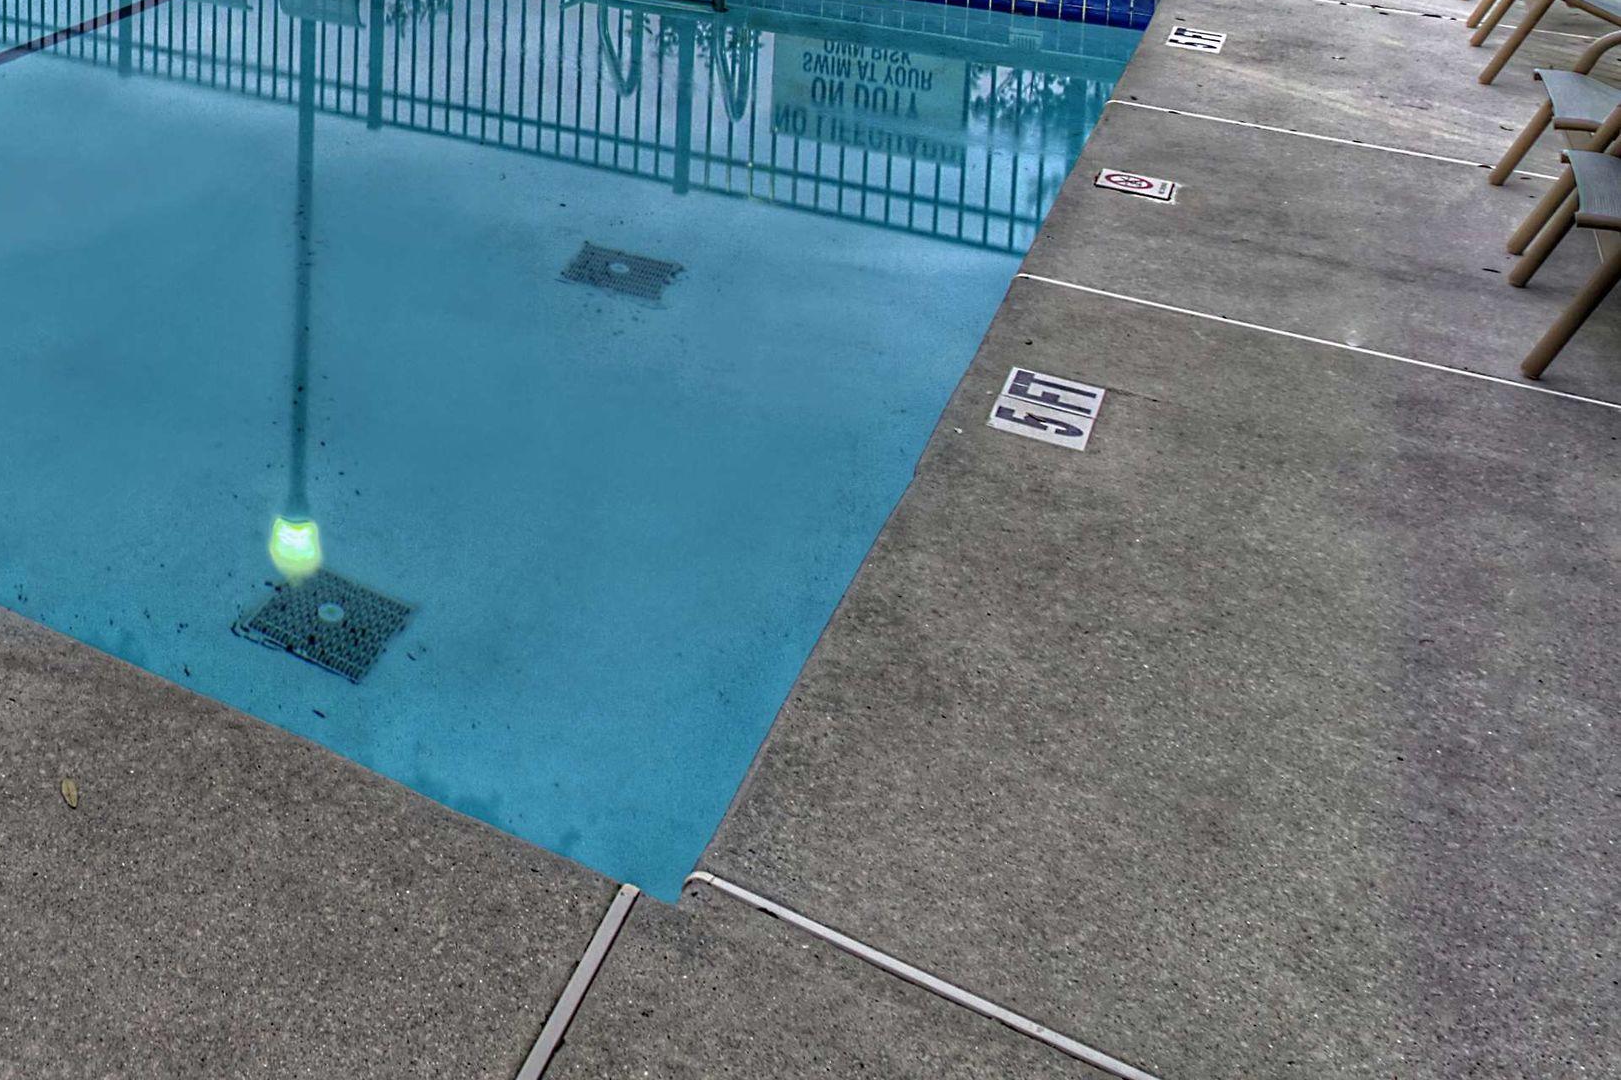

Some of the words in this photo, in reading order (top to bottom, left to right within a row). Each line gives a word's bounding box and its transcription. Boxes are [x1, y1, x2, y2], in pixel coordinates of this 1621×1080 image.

[1174, 28, 1222, 42] FT
[1008, 370, 1097, 415] FT
[995, 406, 1083, 437] 5
